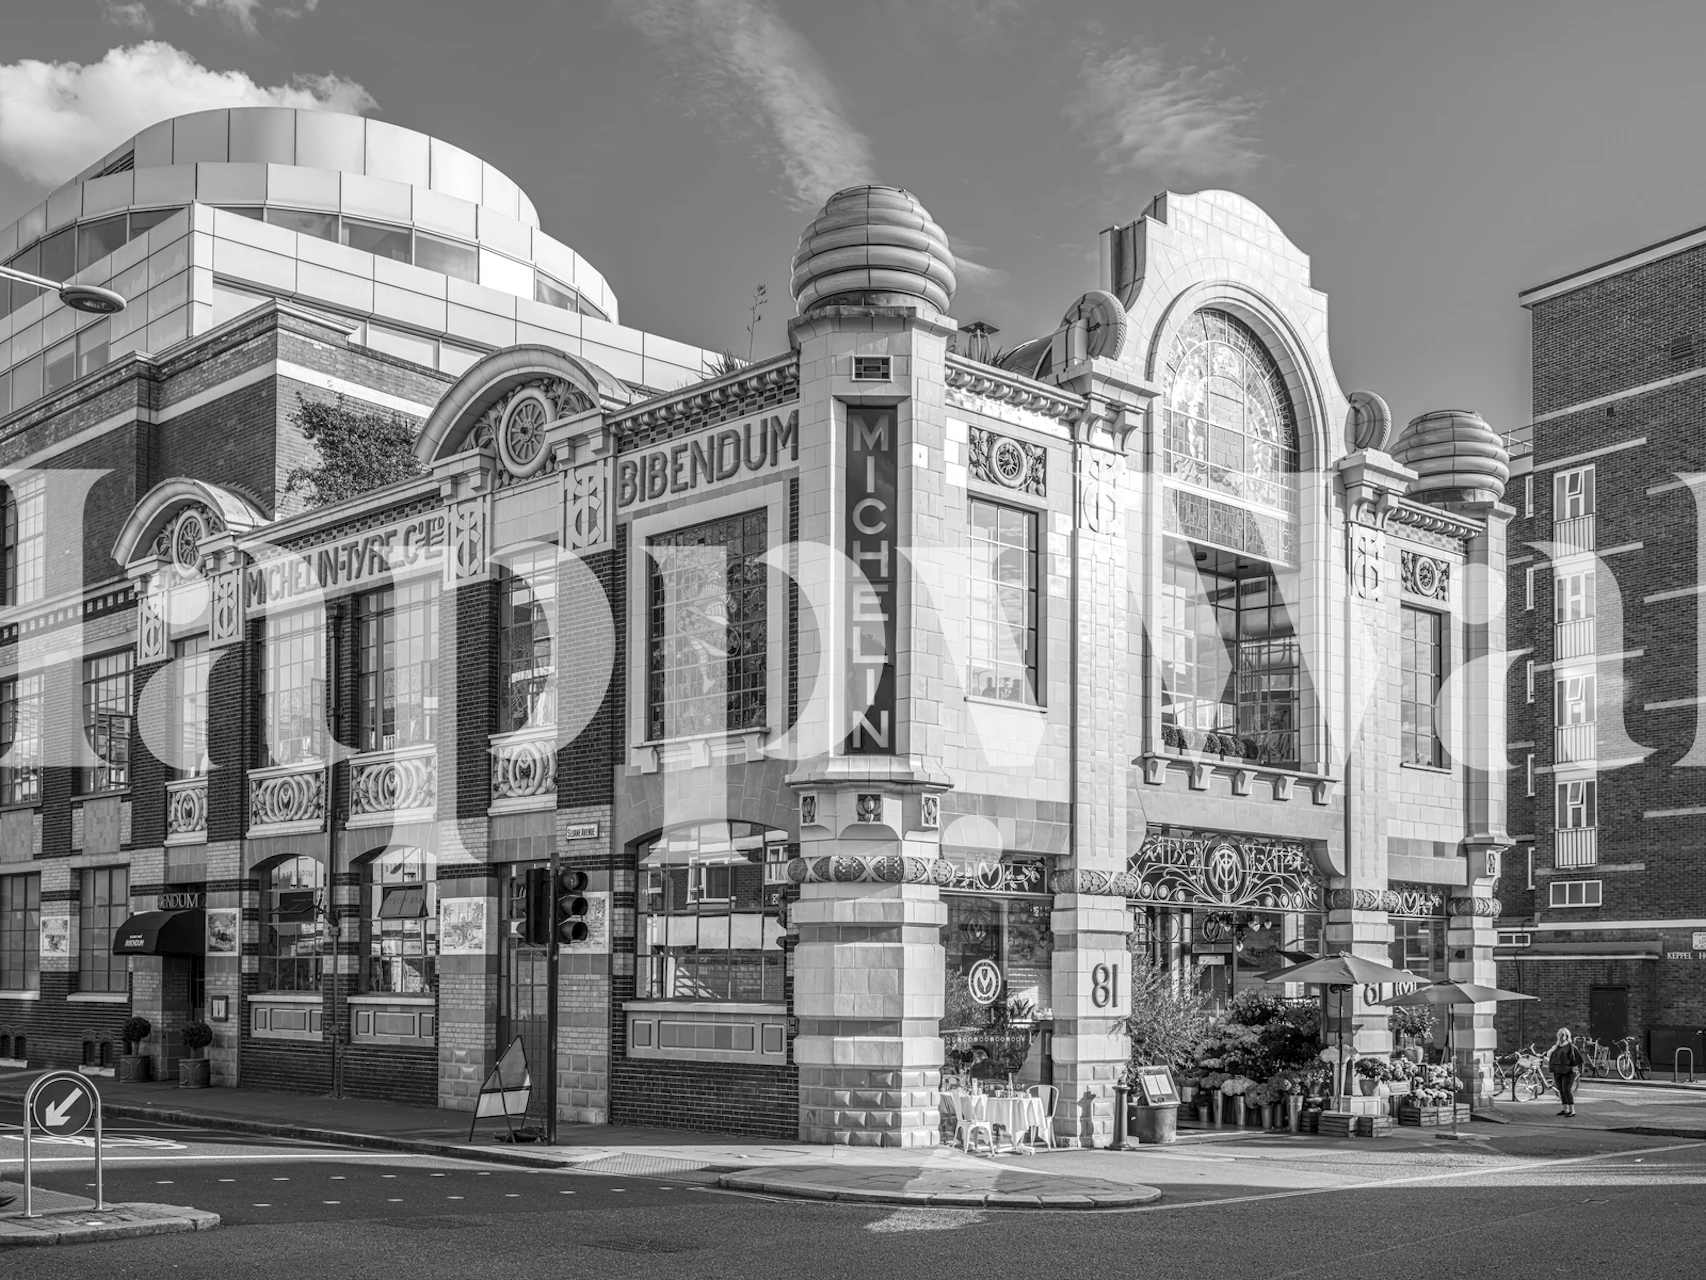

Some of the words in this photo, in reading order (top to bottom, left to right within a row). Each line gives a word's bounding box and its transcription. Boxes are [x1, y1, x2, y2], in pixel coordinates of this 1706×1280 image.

[618, 409, 799, 508] BIBENDUM
[245, 528, 406, 609] MICHELIN-TYRE
[852, 414, 889, 750] MICHELIN
[1091, 962, 1119, 1009] 81
